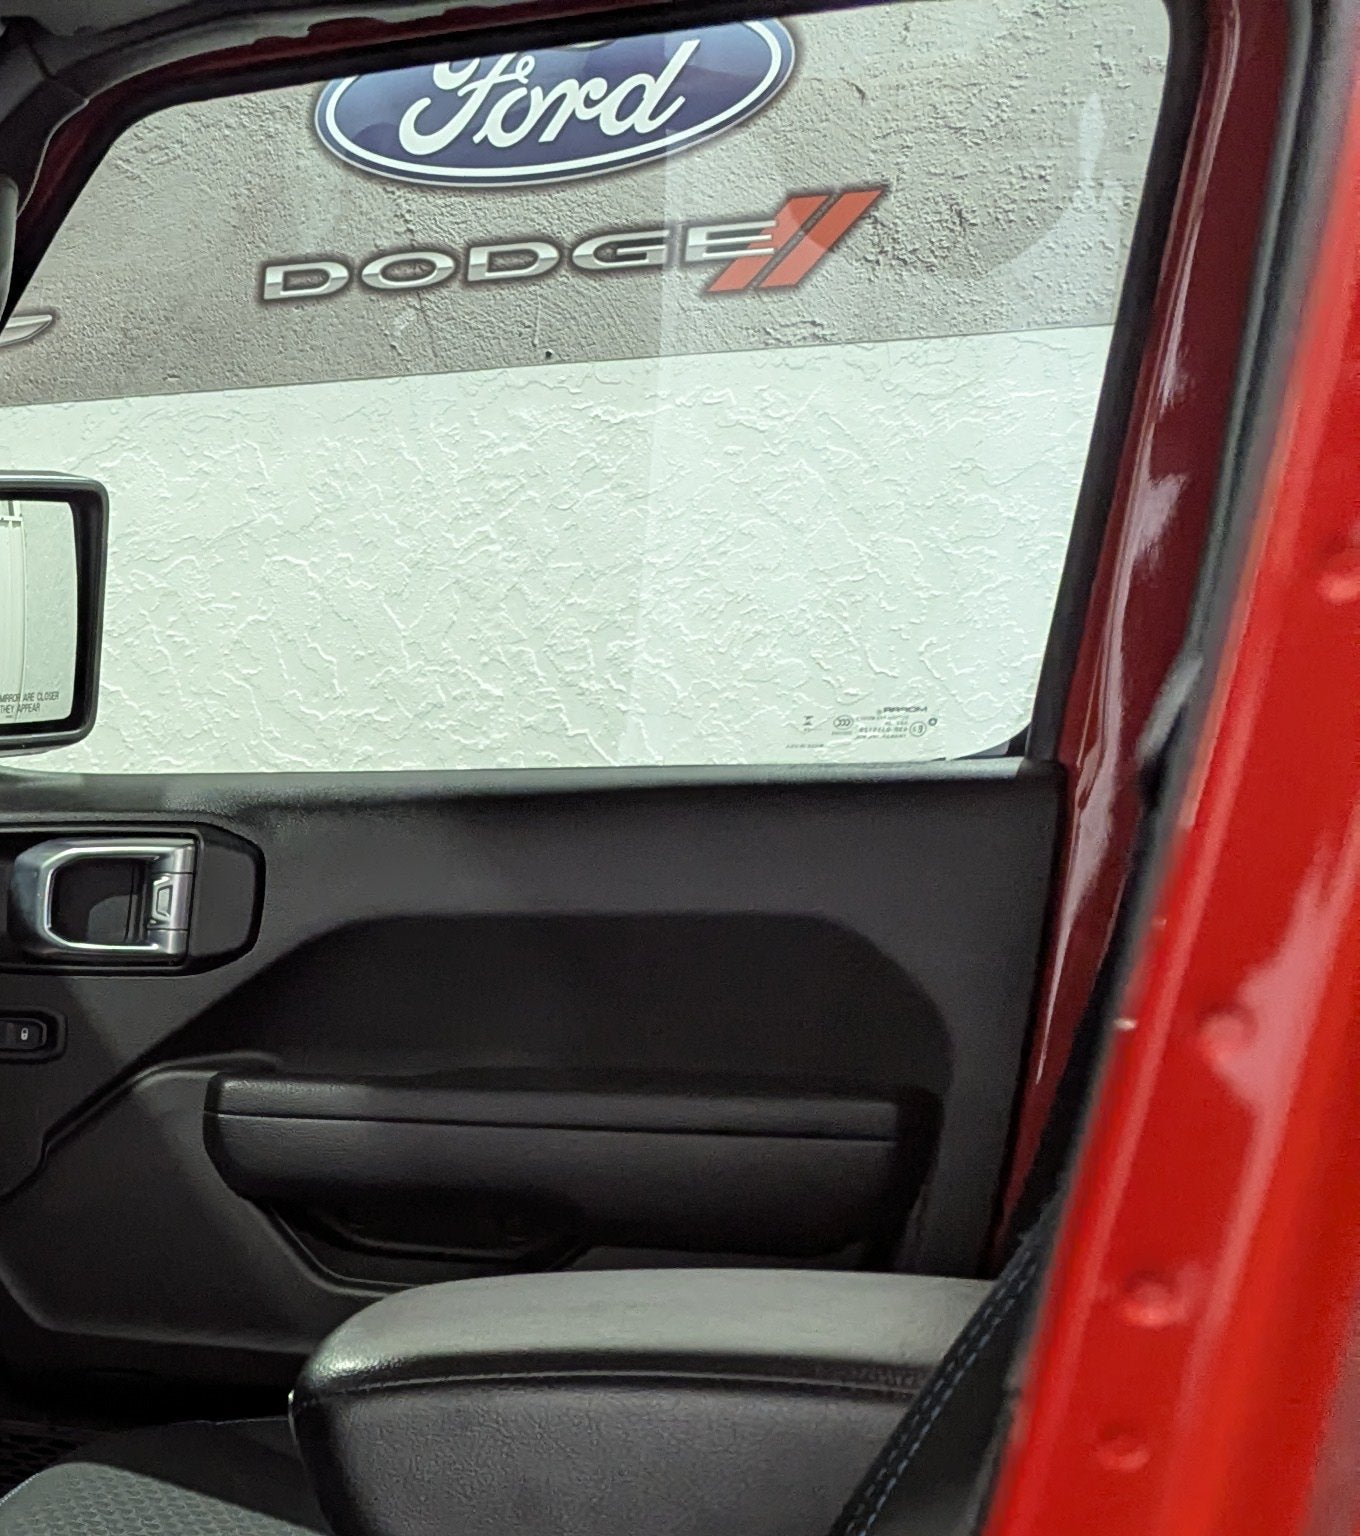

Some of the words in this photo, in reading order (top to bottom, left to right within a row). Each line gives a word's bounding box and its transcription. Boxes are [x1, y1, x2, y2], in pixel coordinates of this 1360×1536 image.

[397, 36, 701, 156] Ford
[262, 218, 782, 301] DODGE
[0, 693, 20, 703] MIRROR
[23, 692, 35, 702] ARE
[37, 690, 60, 701] CLOSER
[0, 704, 14, 714] THEY
[17, 703, 41, 713] APPEAR
